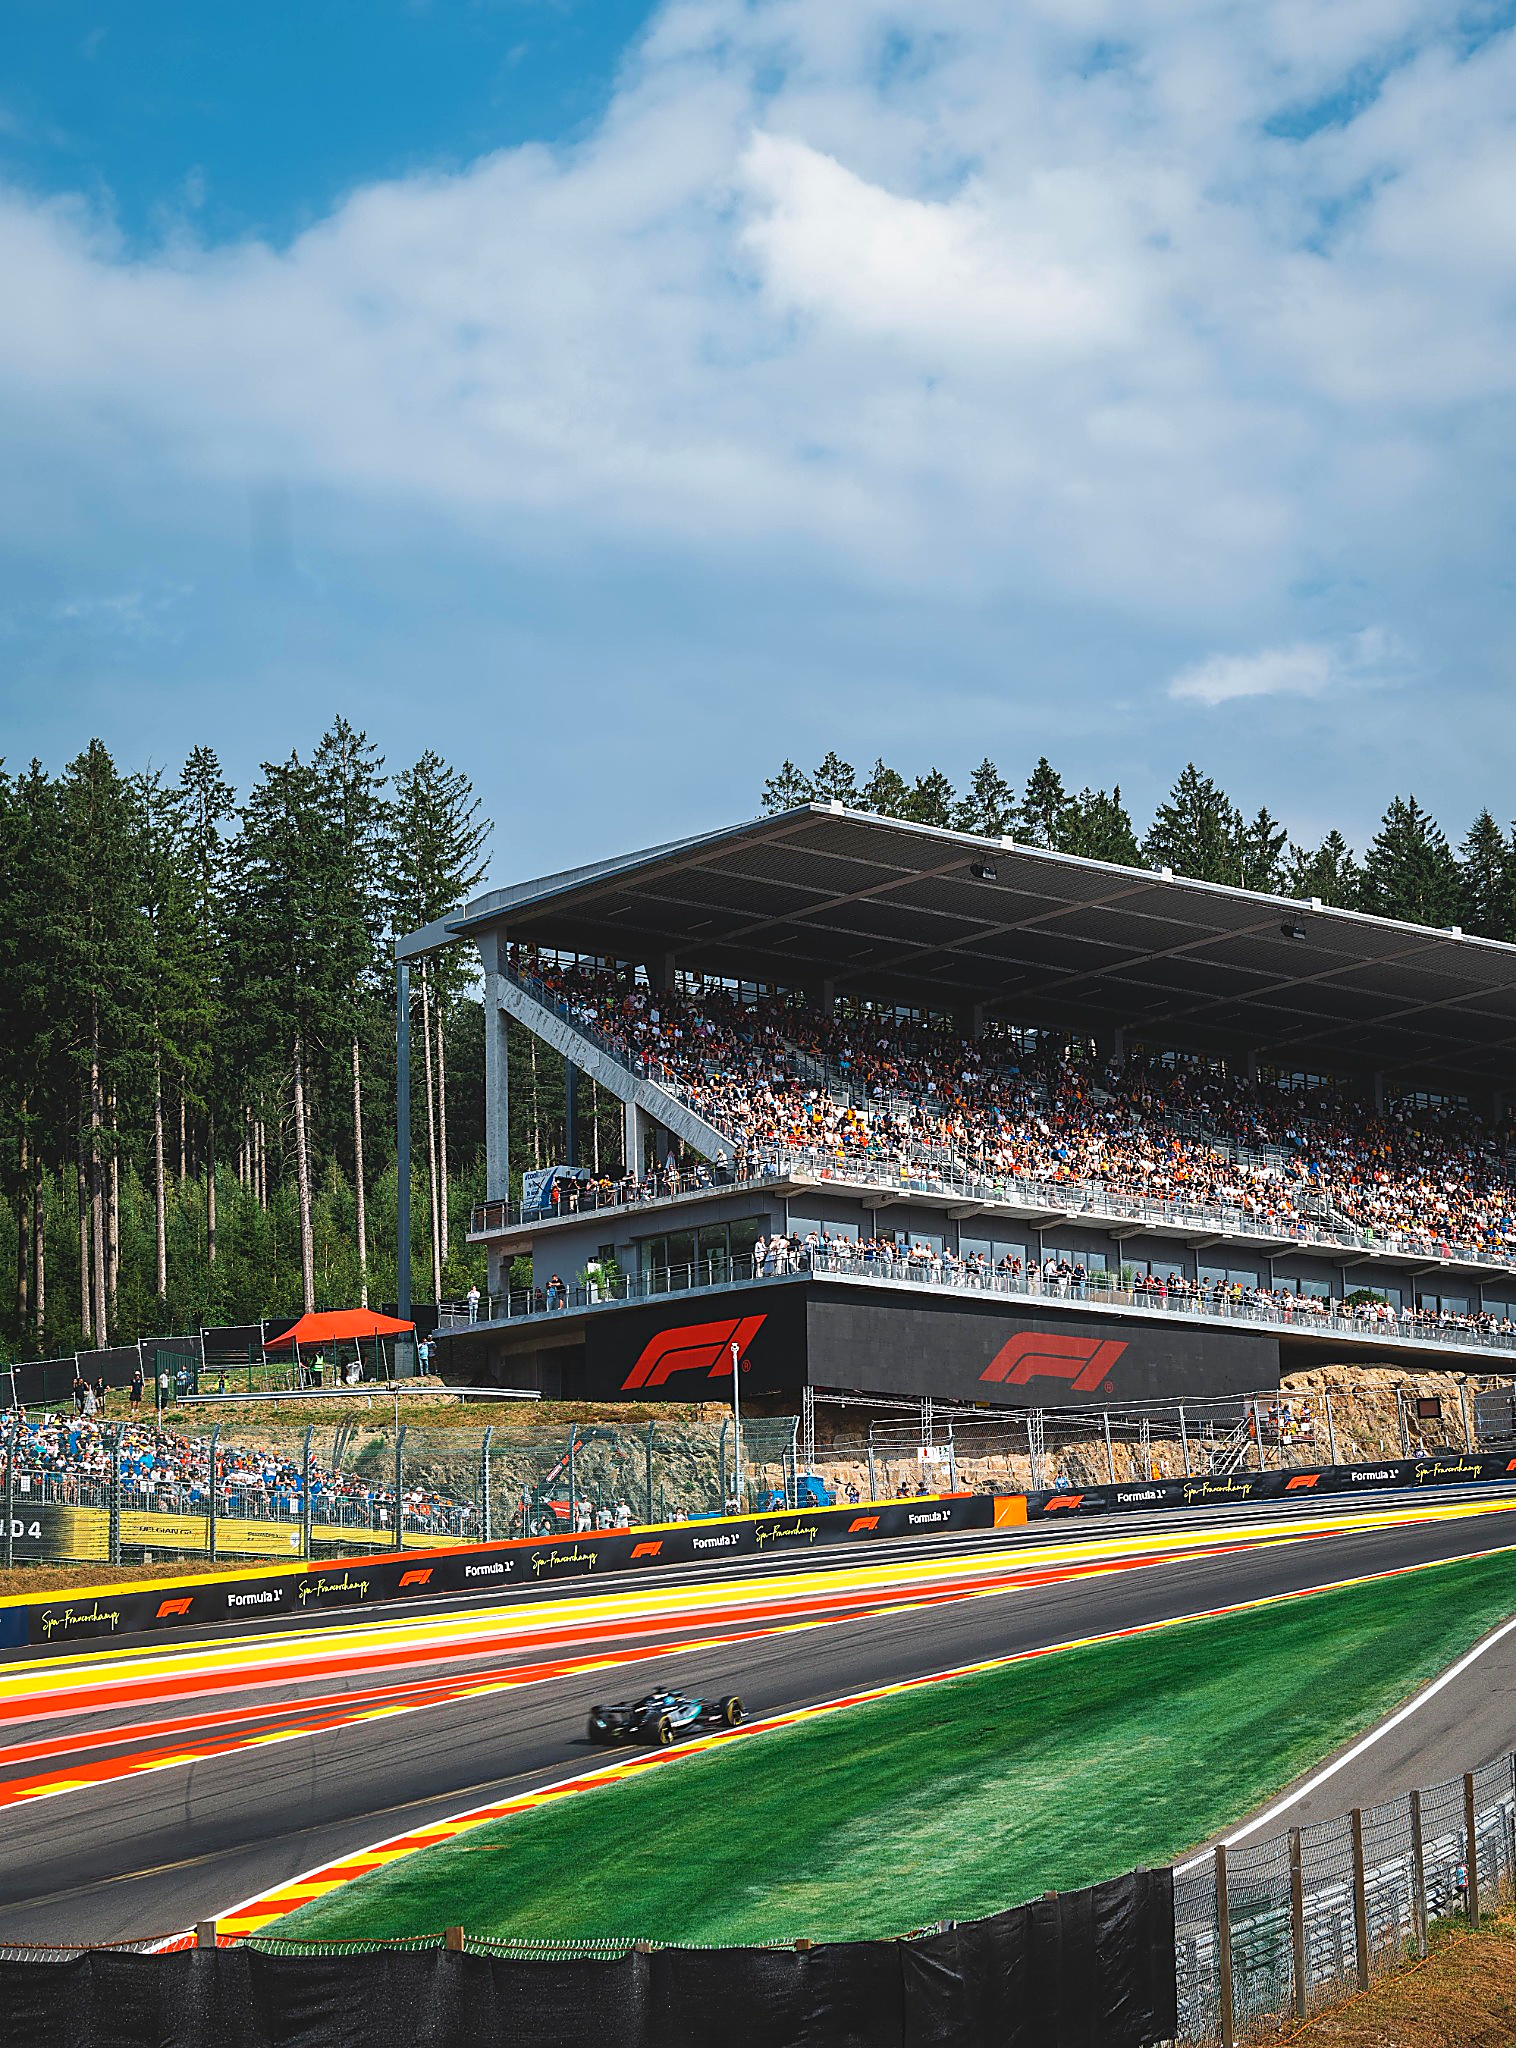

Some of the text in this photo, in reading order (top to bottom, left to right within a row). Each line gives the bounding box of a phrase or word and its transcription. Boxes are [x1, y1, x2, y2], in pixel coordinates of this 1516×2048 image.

[1351, 1470, 1389, 1482] Formula
[1116, 1490, 1157, 1503] Formula
[908, 1512, 942, 1525] Formula
[692, 1536, 730, 1549] Formula
[465, 1563, 504, 1577] Formula
[227, 1591, 273, 1607] Formula
